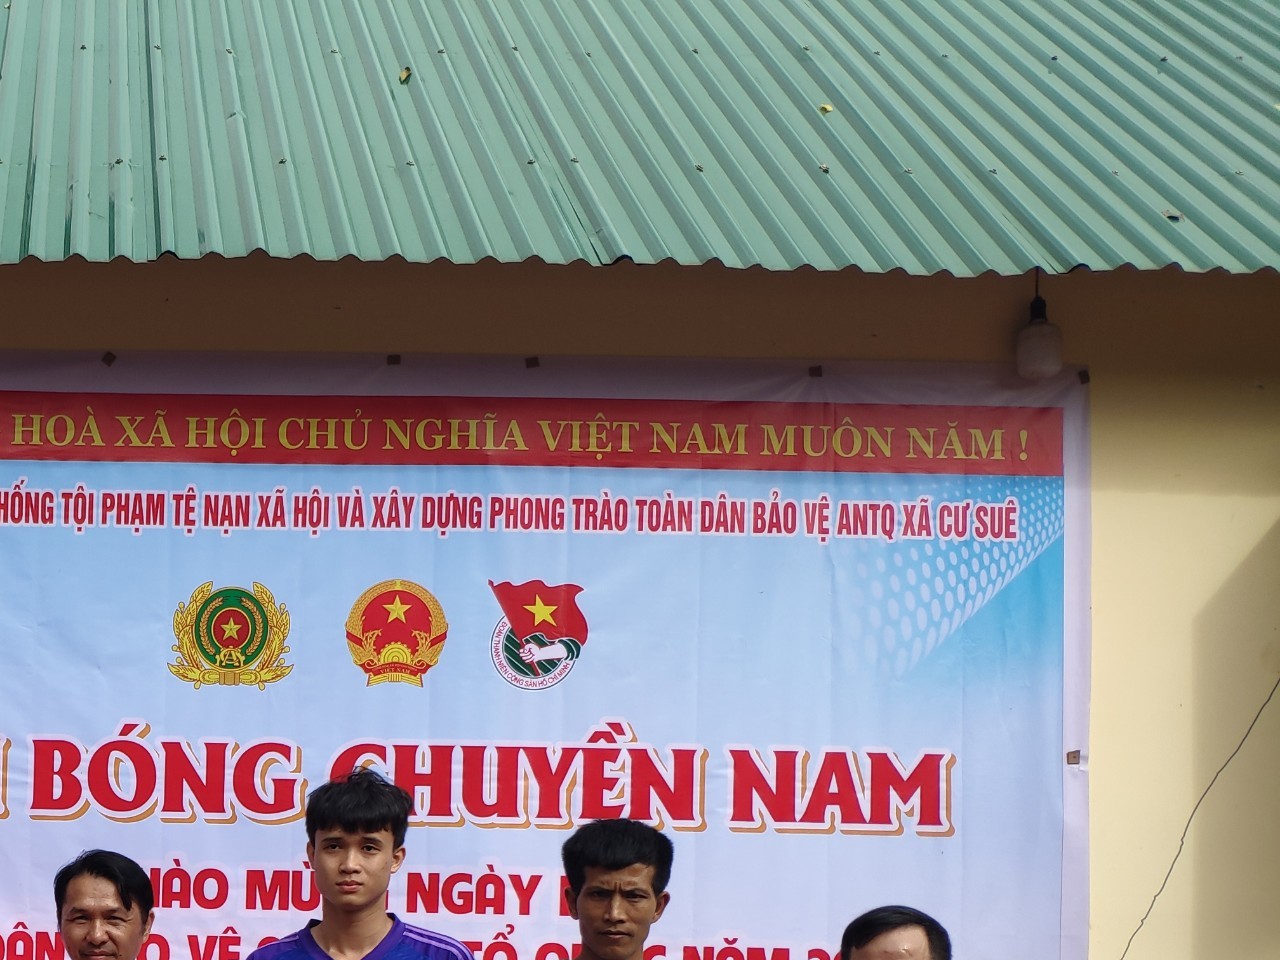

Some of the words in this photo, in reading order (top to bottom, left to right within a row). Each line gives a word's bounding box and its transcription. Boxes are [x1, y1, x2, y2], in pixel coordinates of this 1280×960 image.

[11, 408, 105, 447] HOÀ
[114, 409, 175, 448] XÃ
[185, 408, 265, 456] HỘI
[278, 408, 371, 450] CHỦ
[383, 413, 528, 451] NGHĨA
[537, 413, 640, 453] VIỆT
[650, 423, 748, 456] NAM
[761, 419, 893, 458] MUÔN
[906, 424, 1005, 461] NĂM
[1020, 430, 1029, 460] !
[62, 488, 95, 532] TỘI
[102, 493, 165, 532] PHẠM
[173, 488, 197, 534] TỆ
[204, 495, 251, 535] NẠN
[257, 488, 286, 528] XÃ
[293, 488, 330, 535] HỘI
[337, 492, 365, 528] VÀ
[372, 489, 415, 528] XÂY
[422, 496, 482, 535] DỰNG
[490, 499, 565, 531] PHONG
[572, 492, 628, 532] TRÀO
[636, 493, 693, 532] TOÀN
[701, 495, 745, 534] DÂN
[753, 491, 797, 534] BẢO
[805, 498, 829, 541] VỆ
[837, 505, 894, 539] ANTQ
[903, 497, 930, 536] XÃ
[939, 500, 972, 538] CƯ
[975, 499, 1017, 539] SUÊ
[29, 723, 302, 824] BÓNG
[728, 748, 951, 827] NAM
[406, 864, 544, 916] NGÀY
